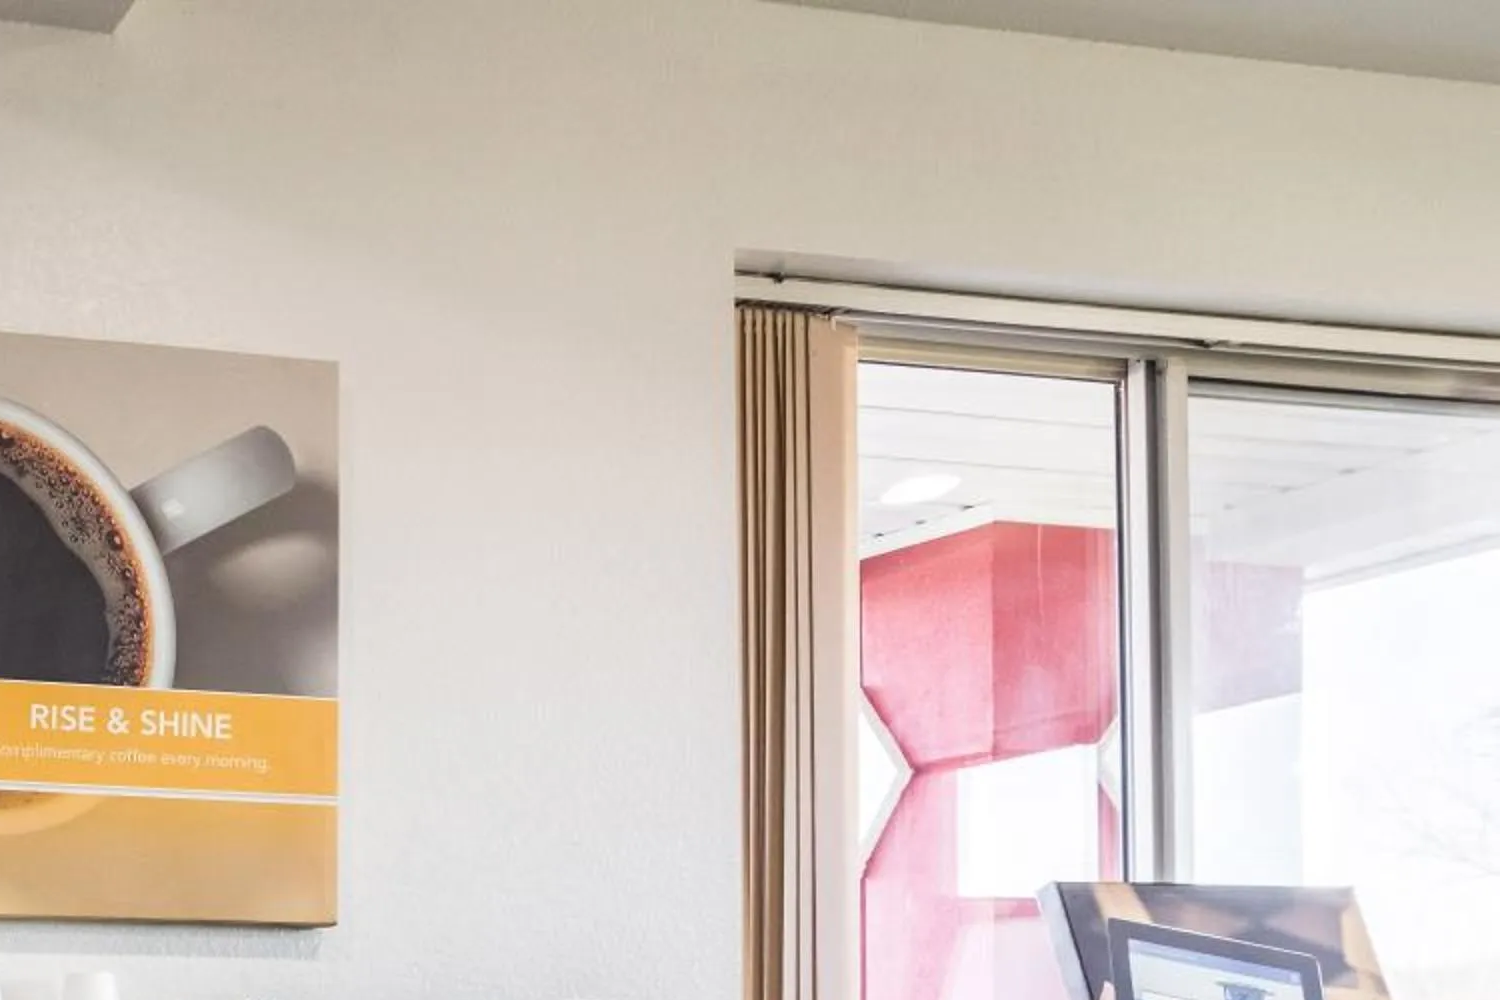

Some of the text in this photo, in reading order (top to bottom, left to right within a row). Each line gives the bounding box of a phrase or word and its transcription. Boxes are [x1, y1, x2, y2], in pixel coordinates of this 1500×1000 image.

[29, 703, 233, 739] RISE & SHINE
[109, 749, 156, 765] coffee
